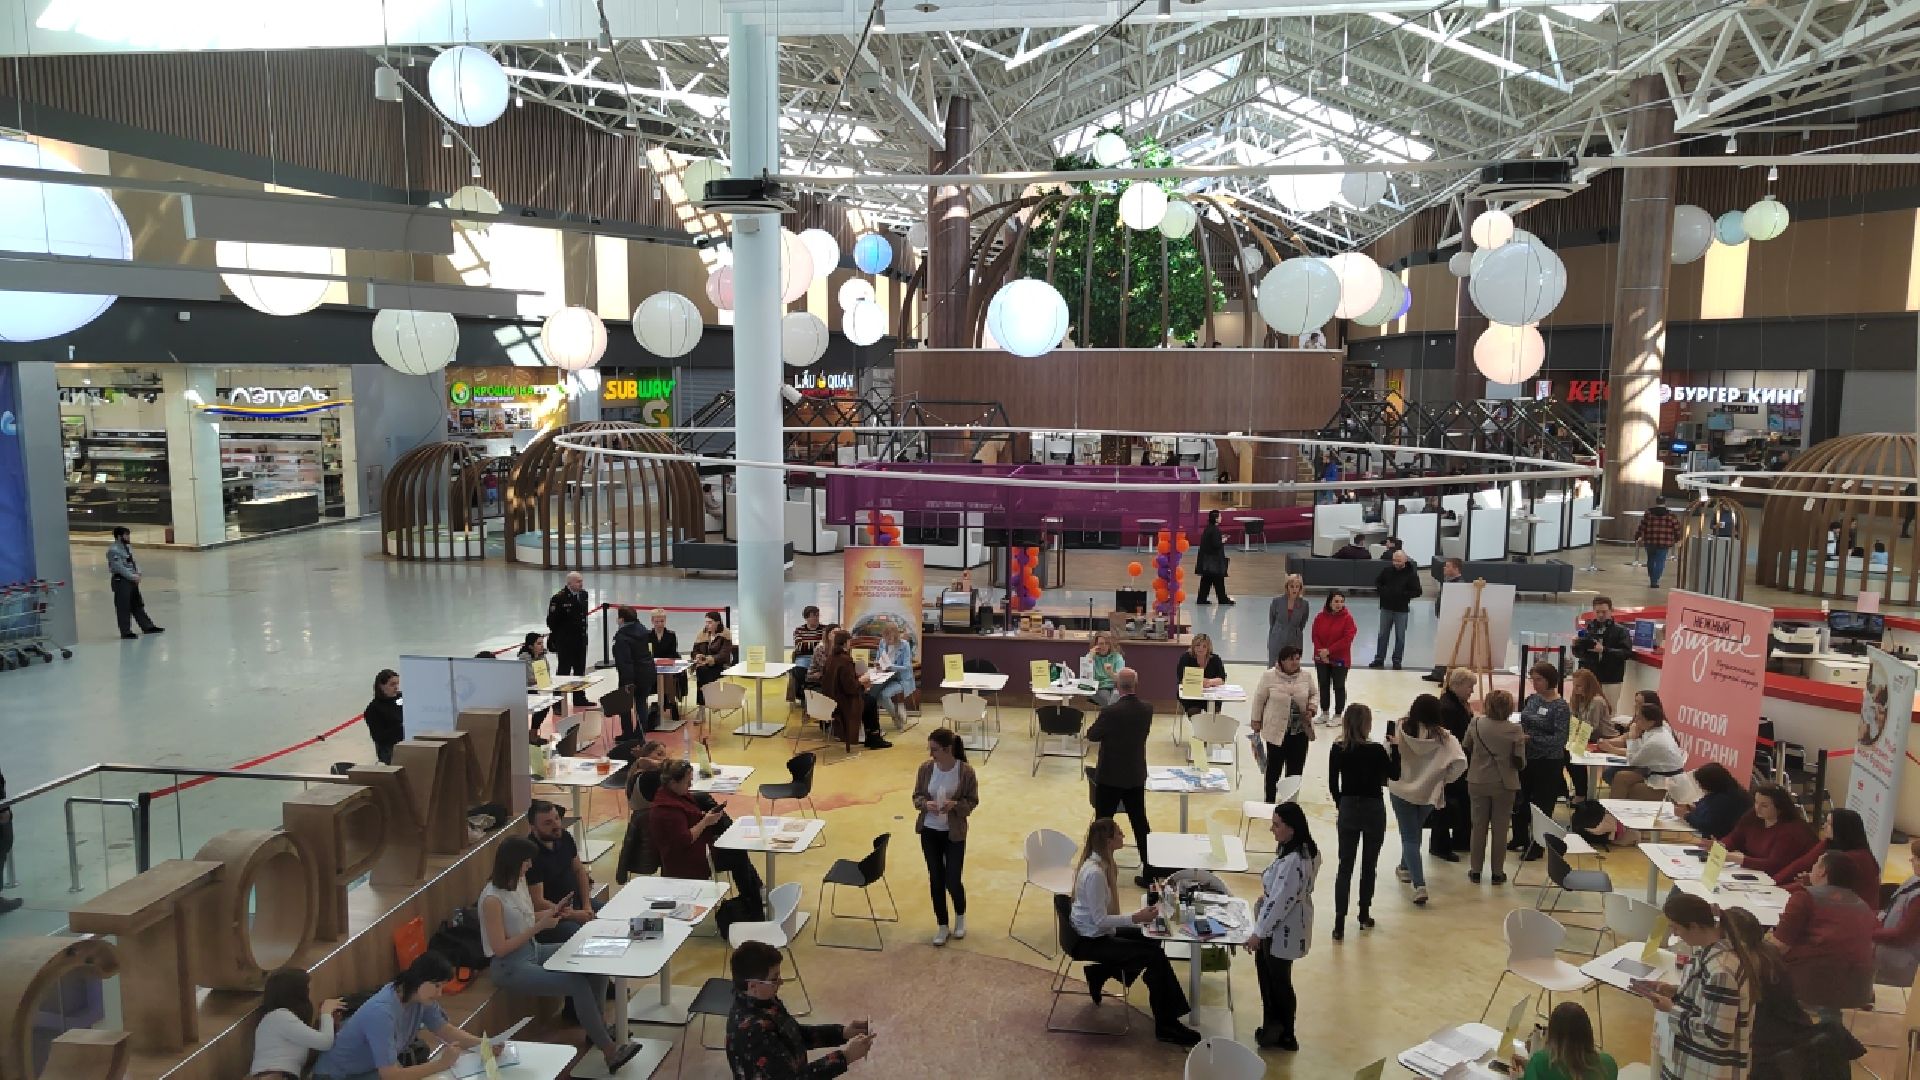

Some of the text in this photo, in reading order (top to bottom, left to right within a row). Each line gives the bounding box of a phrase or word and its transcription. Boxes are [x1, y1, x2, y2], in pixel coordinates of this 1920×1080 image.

[473, 385, 516, 397] КРОШКА
[602, 379, 676, 399] SUBWAY
[1674, 387, 1804, 405] БУРГЕР КИНГ
[1693, 615, 1731, 635] НЕЖНЫЙ
[1678, 704, 1729, 736] ОТКРОЙ
[1695, 738, 1739, 768] ГРАНИ
